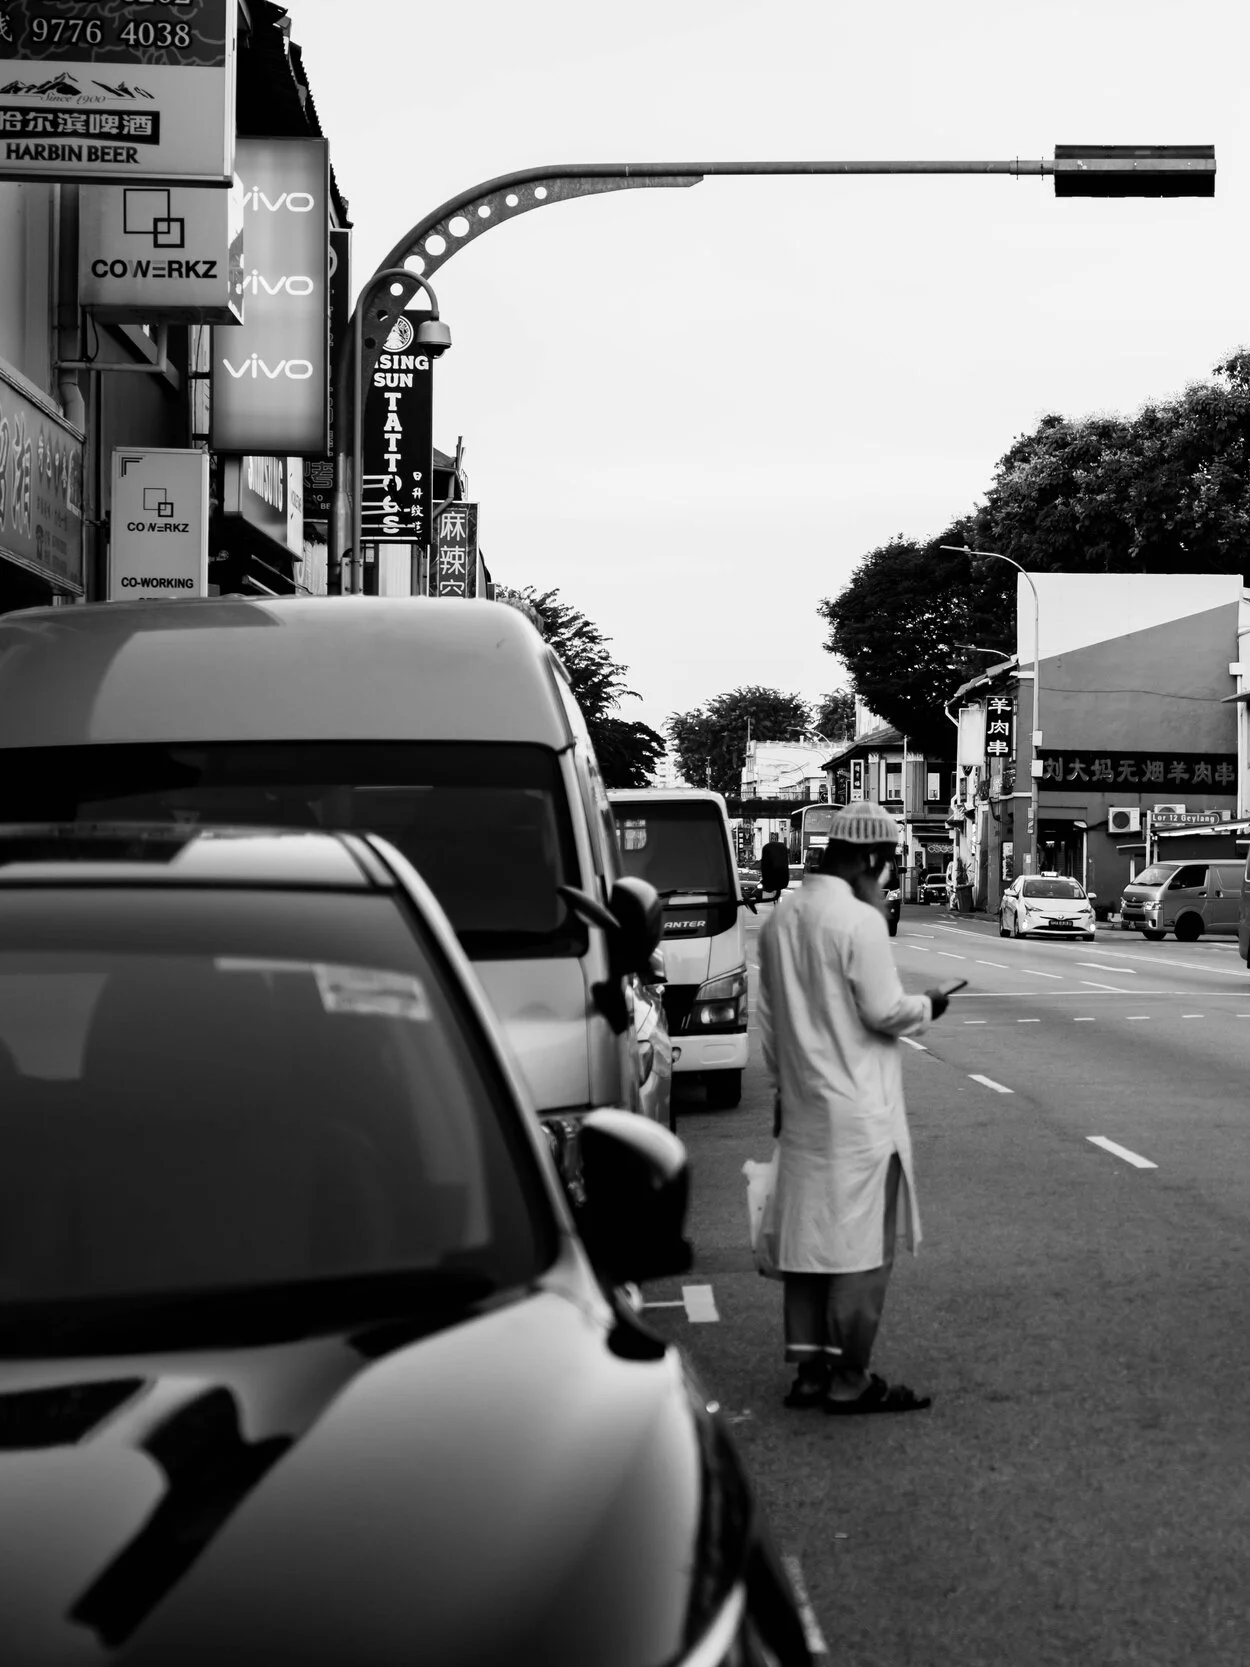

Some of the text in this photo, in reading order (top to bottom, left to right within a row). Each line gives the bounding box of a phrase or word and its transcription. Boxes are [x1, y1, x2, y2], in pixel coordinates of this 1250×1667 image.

[32, 18, 102, 43] 9776
[120, 21, 190, 47] 4038
[41, 92, 106, 104] Since 1900
[0, 110, 152, 135] 哈尔滨啤酒
[6, 143, 140, 164] HARBIN BEER
[222, 353, 313, 380] vivo
[374, 354, 430, 370] SING
[373, 372, 414, 388] SUN
[121, 577, 194, 589] CO-WORKING
[986, 698, 1012, 756] 羊肉串
[1042, 756, 1236, 787] 刘大妈无烟羊肉串
[1181, 814, 1215, 824] Geylang
[663, 919, 706, 928] ANTER
